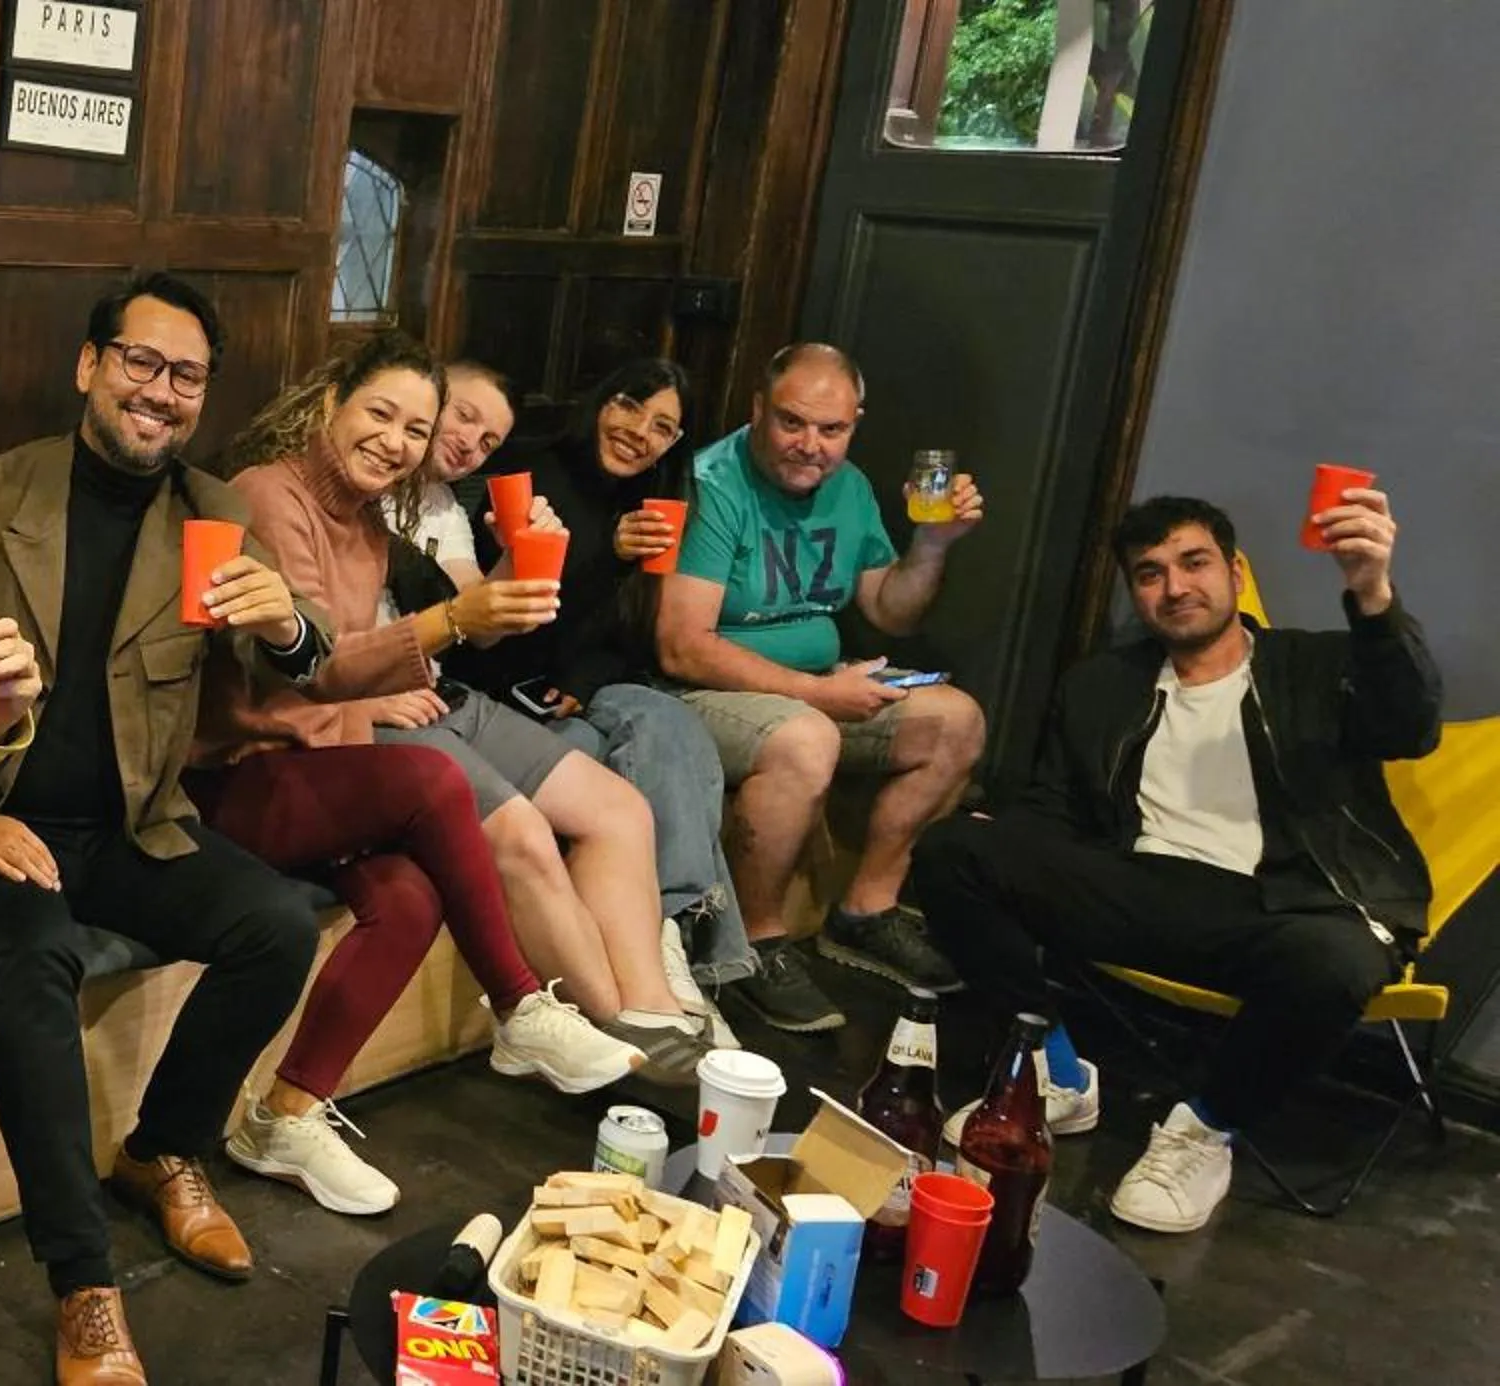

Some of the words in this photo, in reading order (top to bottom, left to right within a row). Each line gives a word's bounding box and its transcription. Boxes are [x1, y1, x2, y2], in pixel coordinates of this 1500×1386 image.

[41, 5, 112, 38] PARIS
[16, 87, 79, 121] BUENOS
[81, 98, 125, 127] AIRES
[762, 525, 845, 604] NZ
[406, 1336, 490, 1361] UNO
